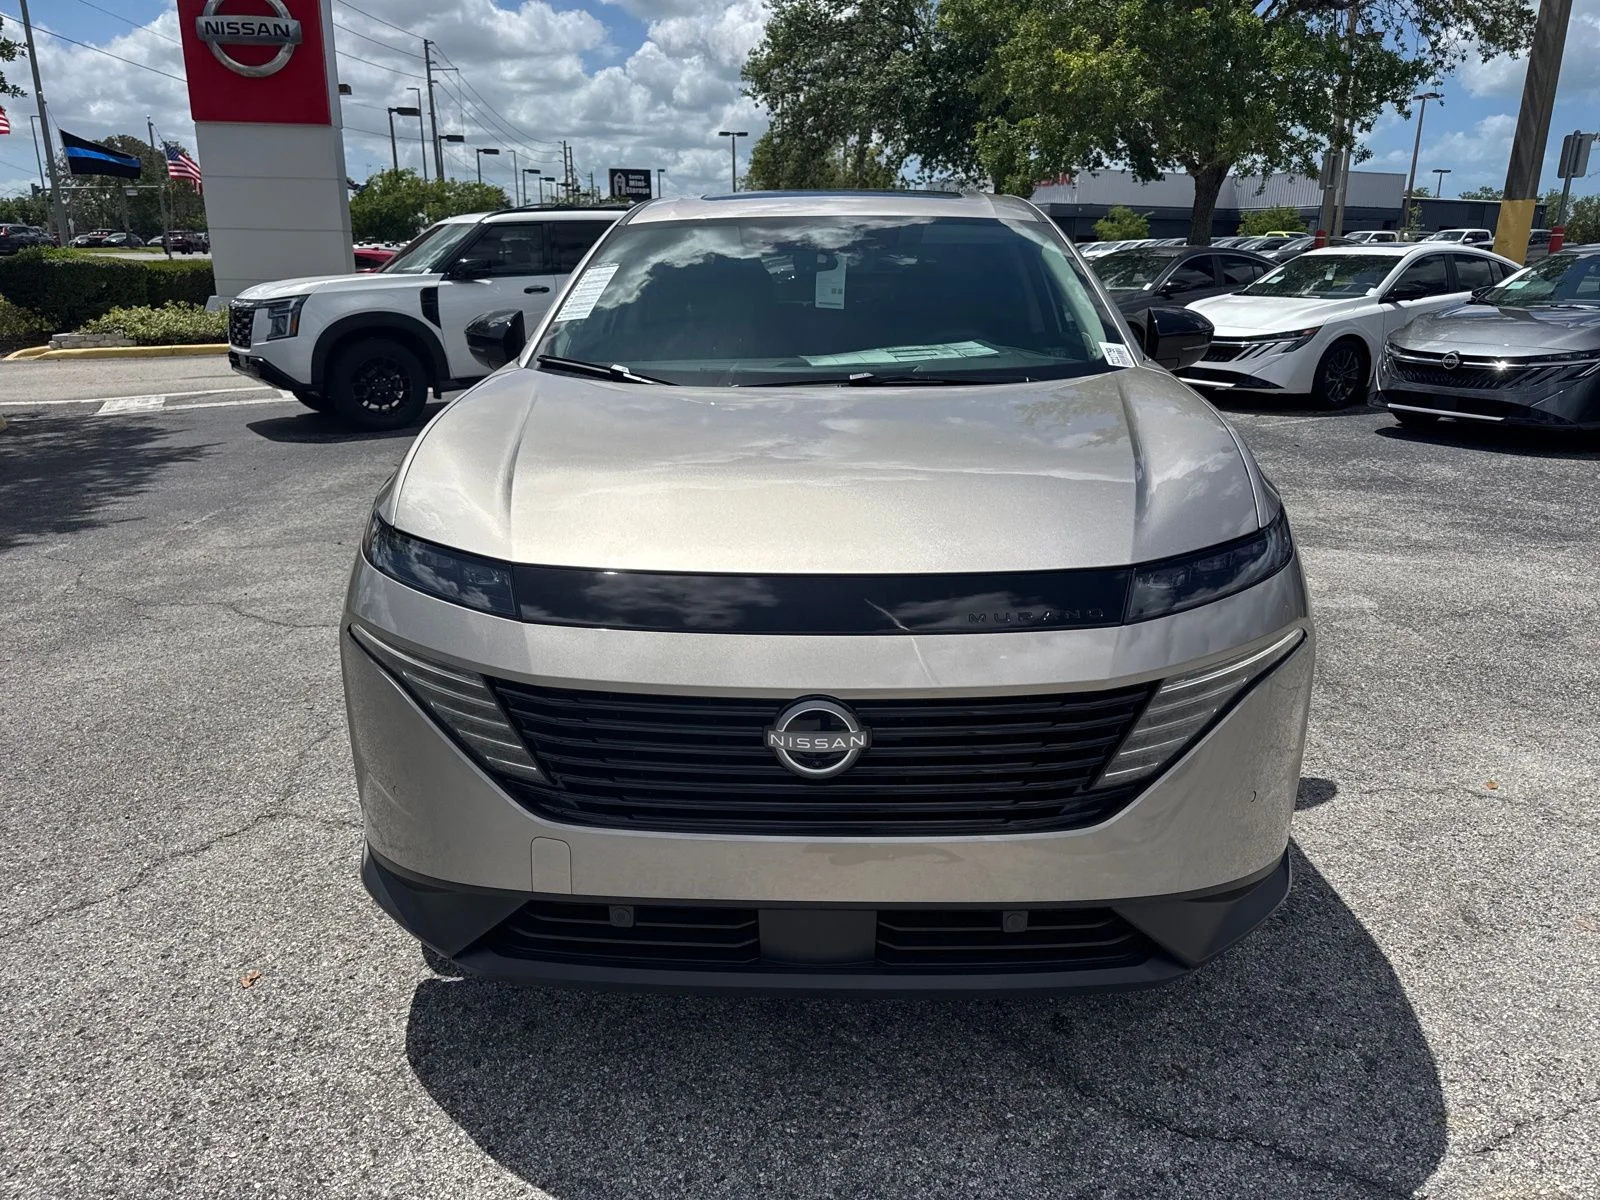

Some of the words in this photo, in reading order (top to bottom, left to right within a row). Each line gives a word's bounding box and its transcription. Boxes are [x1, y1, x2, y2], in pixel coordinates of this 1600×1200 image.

[205, 21, 290, 38] NISSAN
[968, 608, 1104, 624] MURANO
[770, 734, 864, 749] NISSAN
